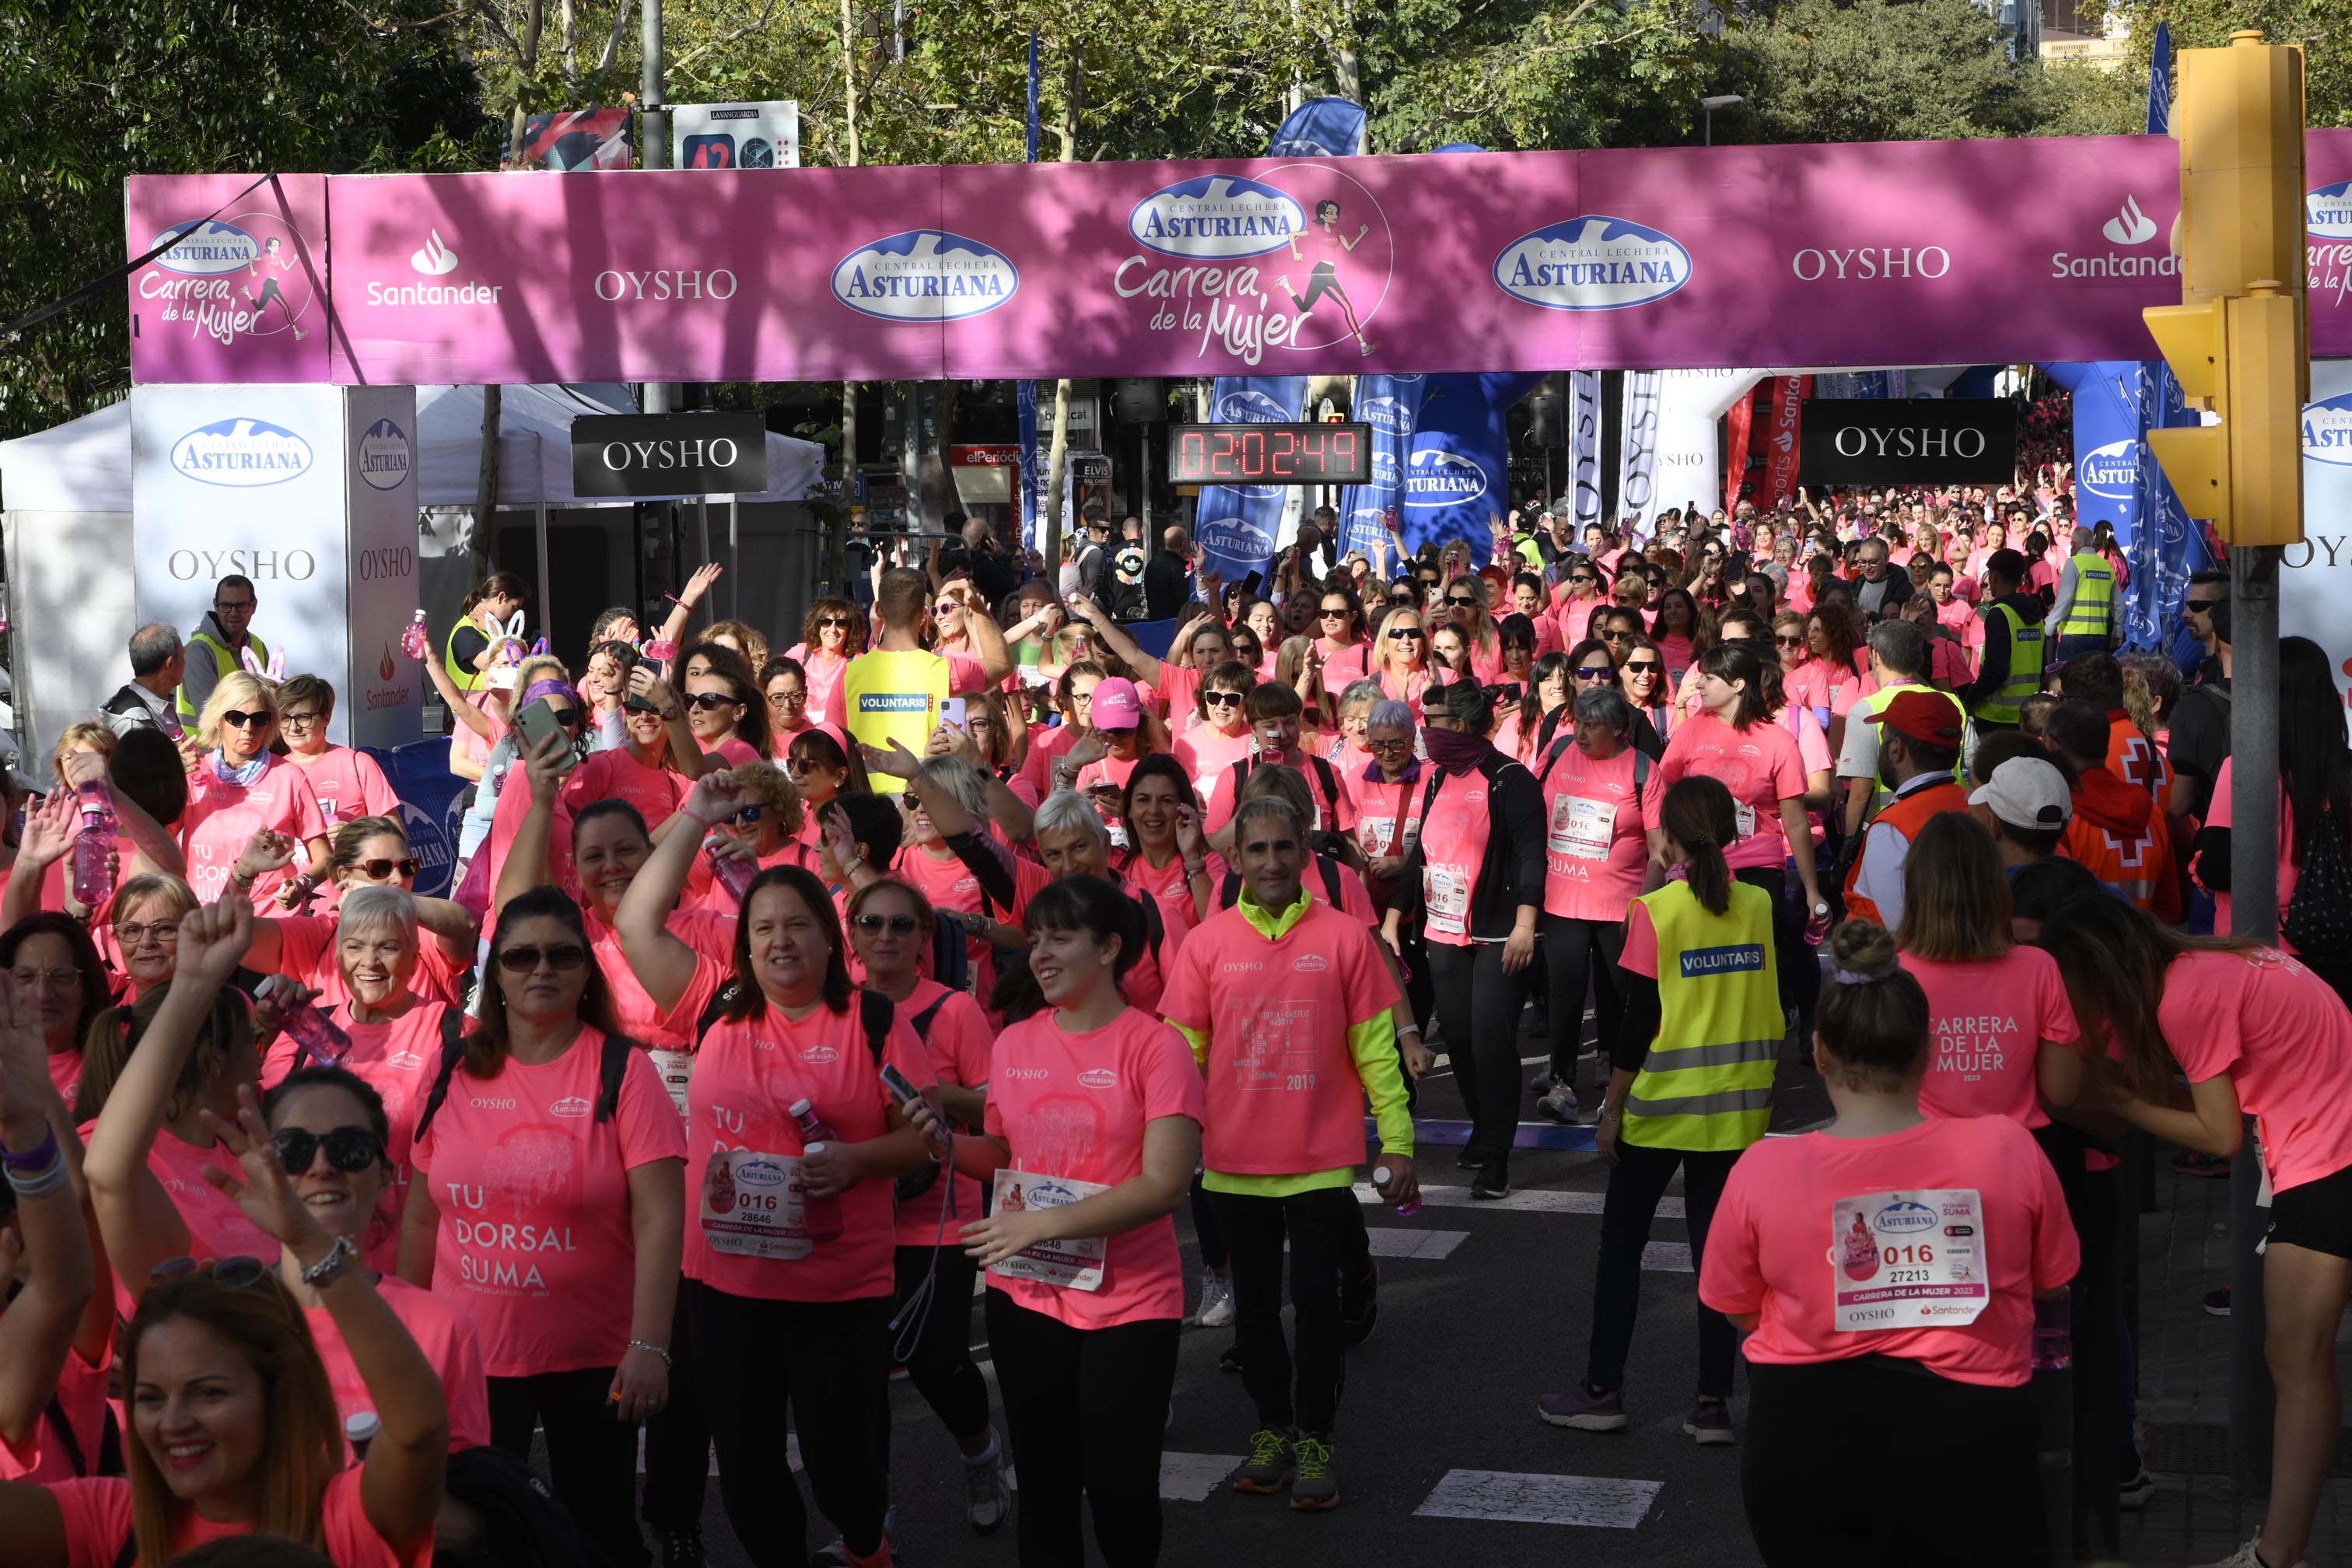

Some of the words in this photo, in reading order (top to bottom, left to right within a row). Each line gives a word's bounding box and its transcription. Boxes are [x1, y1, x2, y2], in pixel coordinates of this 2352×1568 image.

[719, 110, 758, 119] VANGUARDIA
[1170, 204, 1226, 213] CENTRAL
[1230, 202, 1286, 212] LECHERA
[1143, 206, 1293, 238] ASTURIANA
[1539, 248, 1600, 259] CENTRAL
[1607, 247, 1671, 257] LECHERA
[874, 261, 933, 271] CENTRAL
[939, 261, 997, 270] LECHERA
[1509, 253, 1677, 287] ASTURIANA
[1793, 246, 1951, 281] OYSHO
[140, 271, 230, 299] Carrera
[595, 270, 737, 300] OYSHO
[845, 264, 1003, 298] ASTURIANA
[1114, 255, 1259, 298] Carrera
[2325, 267, 2339, 289] la
[367, 282, 502, 306] Santander
[162, 301, 179, 320] de
[183, 301, 194, 320] la
[193, 297, 264, 345] Mujer
[1150, 301, 1177, 331] de
[1183, 299, 1202, 330] la
[1198, 292, 1314, 366] Mujer
[1780, 375, 1800, 429] Santa
[1835, 426, 1986, 458] OYSHO
[182, 443, 303, 470] ASTURIANA
[362, 445, 408, 473] ASTURIANA
[603, 438, 737, 471] OYSHO
[1182, 432, 1356, 474] 02:02:49
[1657, 452, 1703, 467] YSHO
[1084, 466, 1108, 475] ELVIS
[1407, 478, 1479, 492] TURIANA
[1203, 530, 1272, 557] ASTURIANA
[169, 549, 315, 581] OYSHO
[360, 546, 411, 581] OYSHO
[366, 685, 411, 711] Santander
[861, 698, 926, 708] VOLUNTARIS
[192, 844, 212, 859] TU
[196, 865, 229, 883] DOR
[1548, 856, 1589, 877] SUMA
[1224, 961, 1263, 972] OYSHO
[1683, 951, 1760, 971] VOLUNTARIS
[1941, 1035, 1966, 1053] DE
[1976, 1034, 2000, 1052] LA
[1937, 1053, 2004, 1072] MUJER
[1006, 1067, 1048, 1080] OYSHO
[1081, 1074, 1115, 1084] ASTURIANA
[1287, 1074, 1316, 1090] 2019
[470, 1097, 516, 1110] OYSHO
[712, 1104, 744, 1134] TU
[740, 1168, 782, 1182] ASTURIANA
[446, 1182, 484, 1209] TU
[739, 1193, 777, 1210] 016
[741, 1213, 772, 1223] 28646
[1943, 1208, 1972, 1216] SUMA
[712, 1223, 742, 1232] CARRERA
[1879, 1215, 1934, 1229] ASTURIANA
[457, 1218, 578, 1252] DORSAL
[709, 1236, 743, 1246] OYSHO
[1052, 1254, 1075, 1264] MUJER
[1884, 1244, 1934, 1265] 016
[460, 1255, 546, 1288] SUMA
[1058, 1269, 1094, 1282] Santander
[1890, 1269, 1930, 1283] 27213
[1853, 1290, 1893, 1302] CARRERA
[1894, 1289, 1906, 1298] DE
[1908, 1287, 1920, 1297] LA
[1922, 1287, 1951, 1297] MUJER
[1850, 1308, 1895, 1323] OYSHO
[1933, 1305, 1978, 1315] Santander
